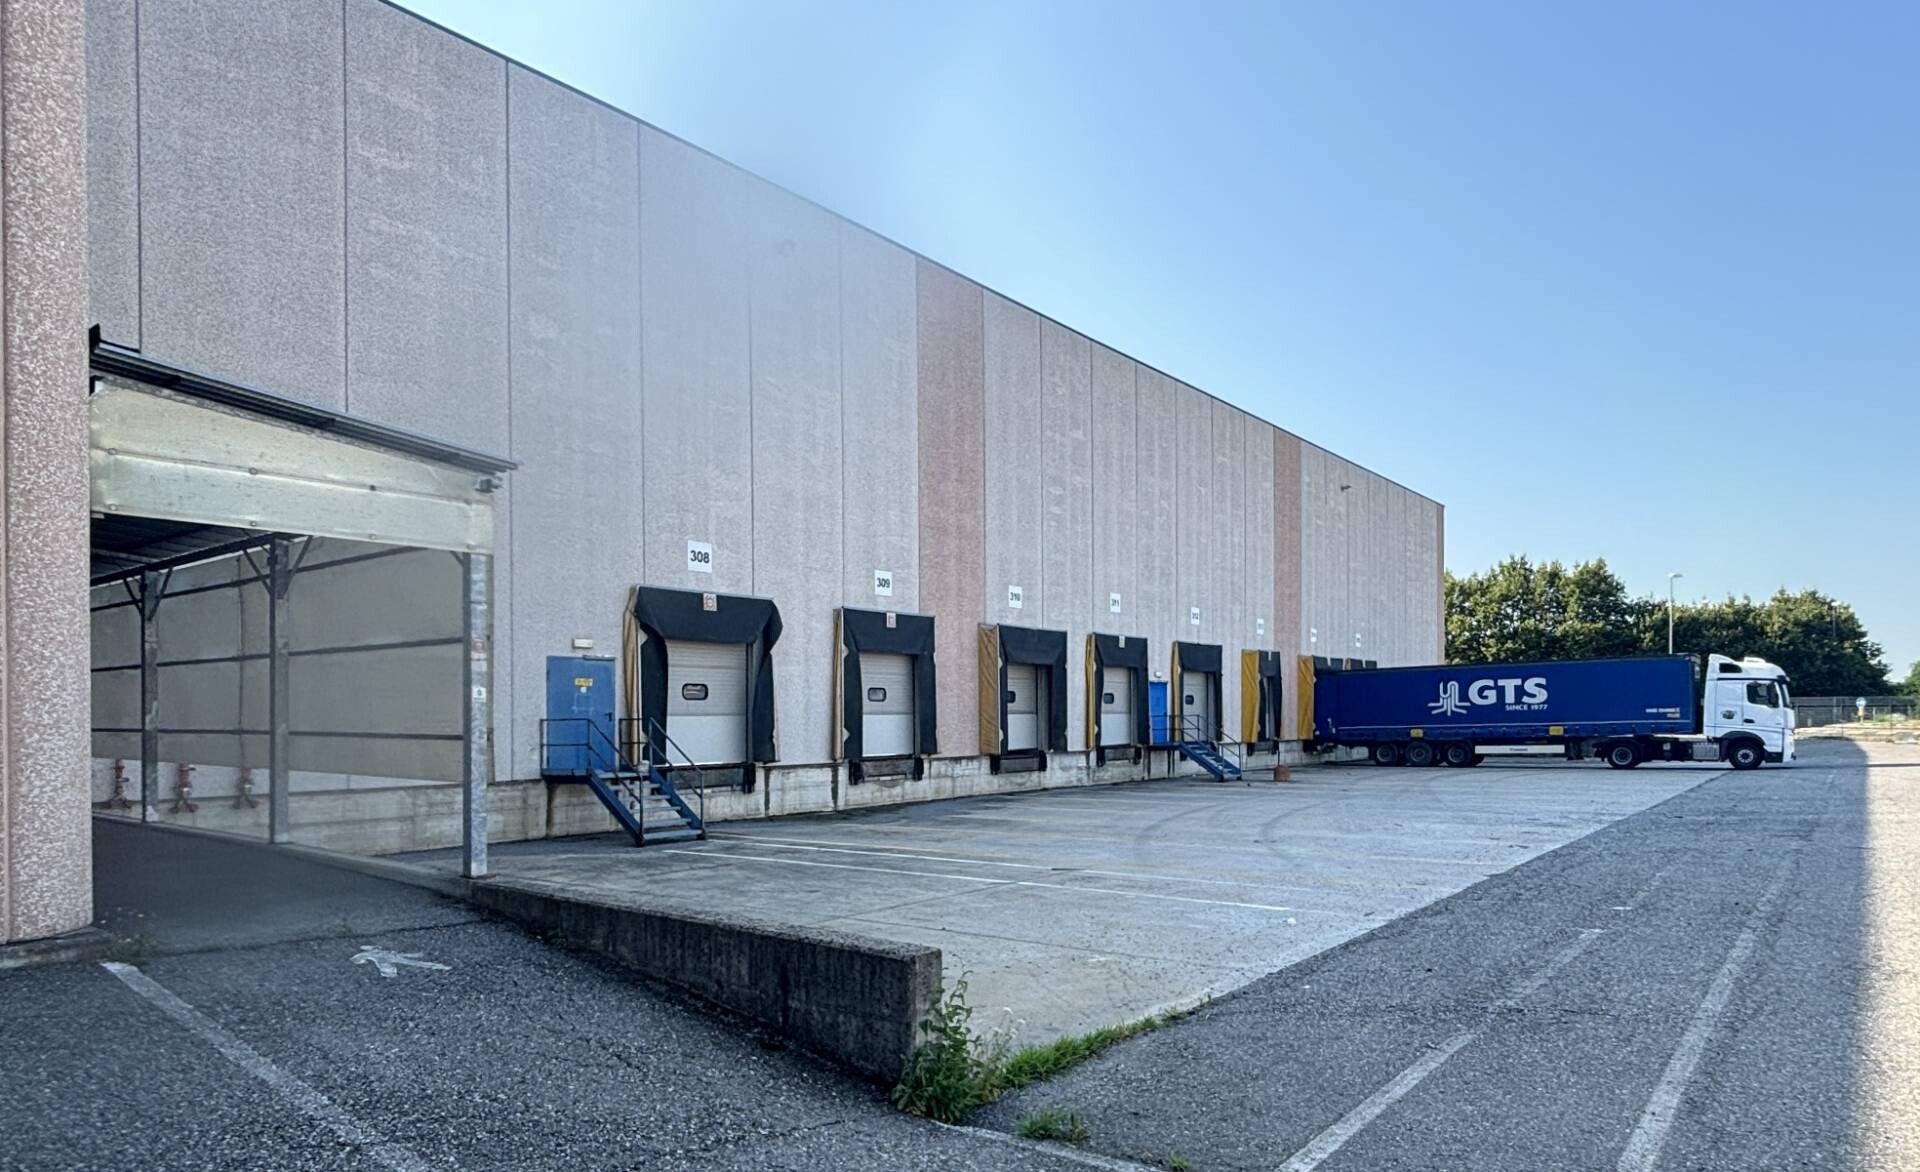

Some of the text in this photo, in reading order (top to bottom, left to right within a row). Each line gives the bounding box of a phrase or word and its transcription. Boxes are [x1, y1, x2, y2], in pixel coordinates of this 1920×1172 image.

[690, 550, 710, 563] 308
[876, 577, 890, 588] 309
[1468, 677, 1548, 705] GTS
